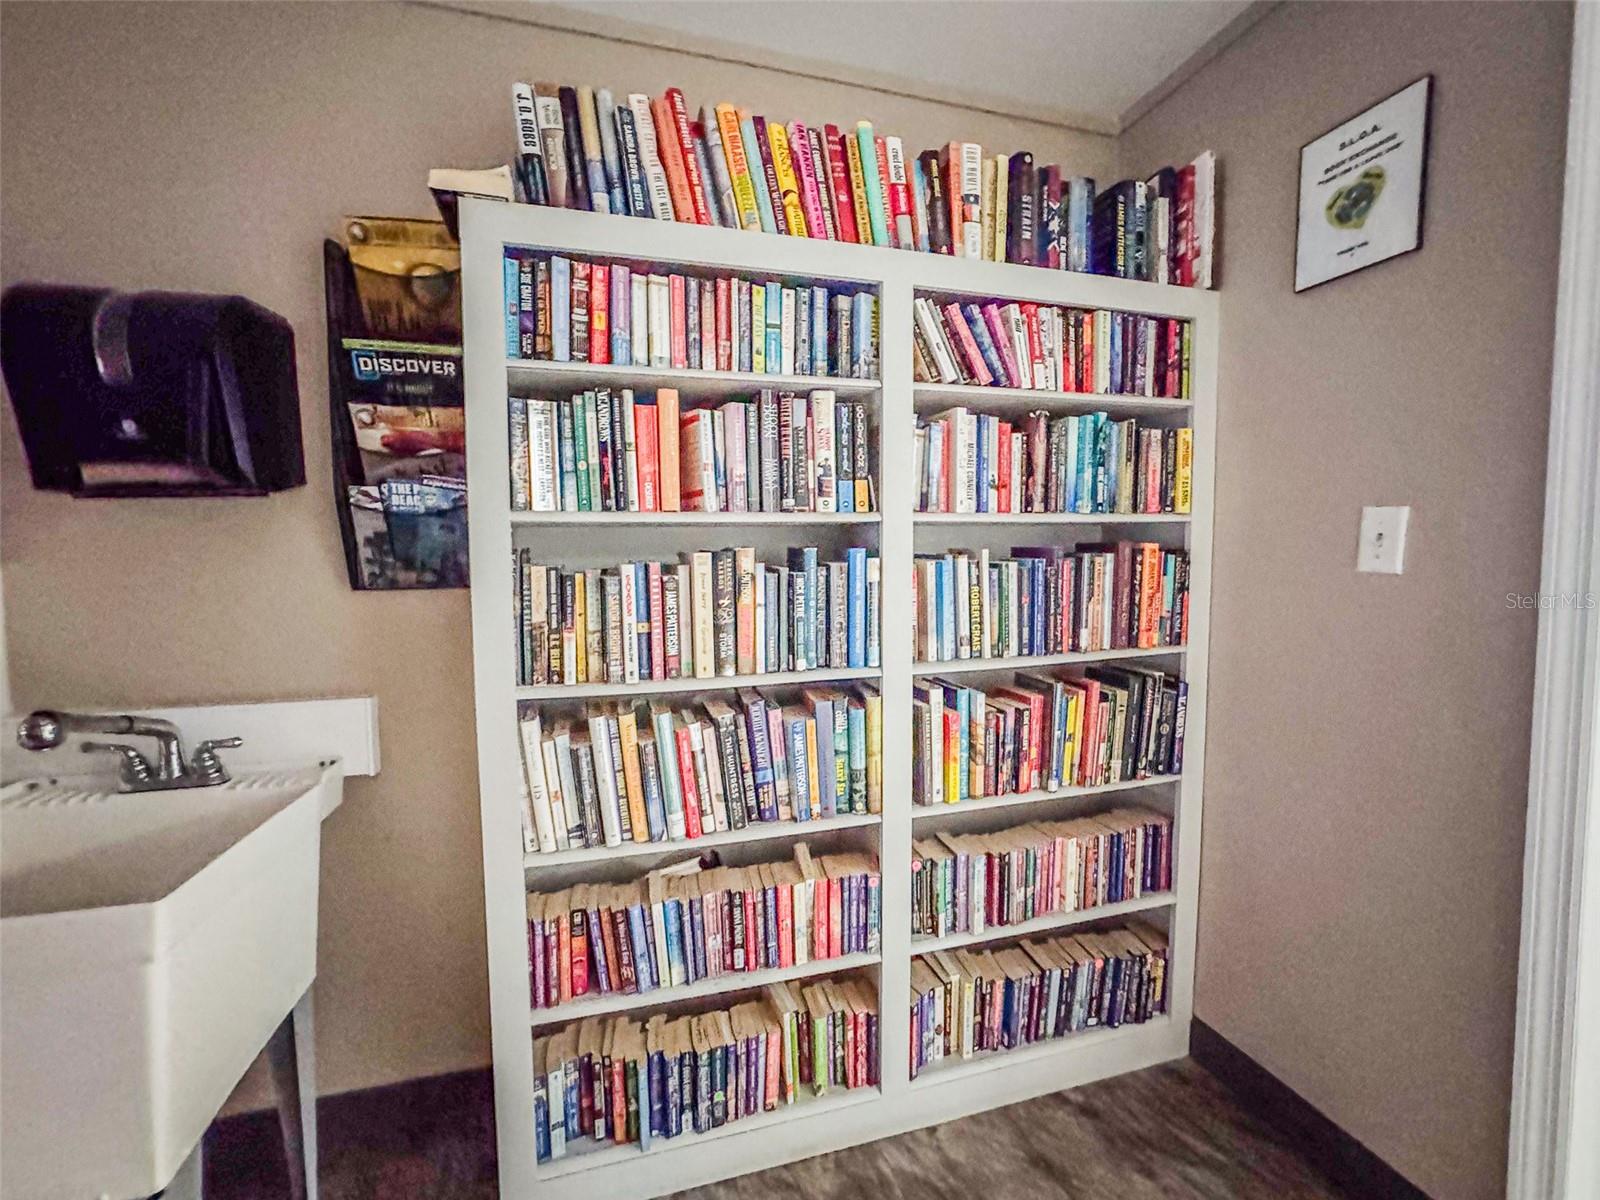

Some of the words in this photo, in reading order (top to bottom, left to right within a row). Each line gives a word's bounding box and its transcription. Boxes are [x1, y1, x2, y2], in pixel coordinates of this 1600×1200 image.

[520, 119, 536, 147] ROBB
[623, 125, 635, 153] SANDRA
[796, 125, 805, 140] IAN
[627, 154, 639, 179] BROWN
[727, 135, 746, 176] HIAASEN
[738, 176, 754, 211] SQUEEZE
[800, 143, 814, 179] RANKIN
[893, 164, 904, 182] doubt
[1022, 195, 1032, 239] STRAIN
[521, 273, 531, 283] SUE
[521, 285, 532, 311] GRAFTON
[666, 591, 677, 614] JAMES
[971, 586, 980, 622] ROBERT
[666, 615, 678, 656] PATTERSON
[720, 633, 728, 658] STORM
[972, 624, 980, 651] CRAIS
[724, 736, 733, 753] THE
[794, 733, 803, 755] JAMES
[726, 755, 739, 798] HUNTRESS
[796, 755, 805, 795] PATTERSON
[837, 759, 846, 782] SILENT
